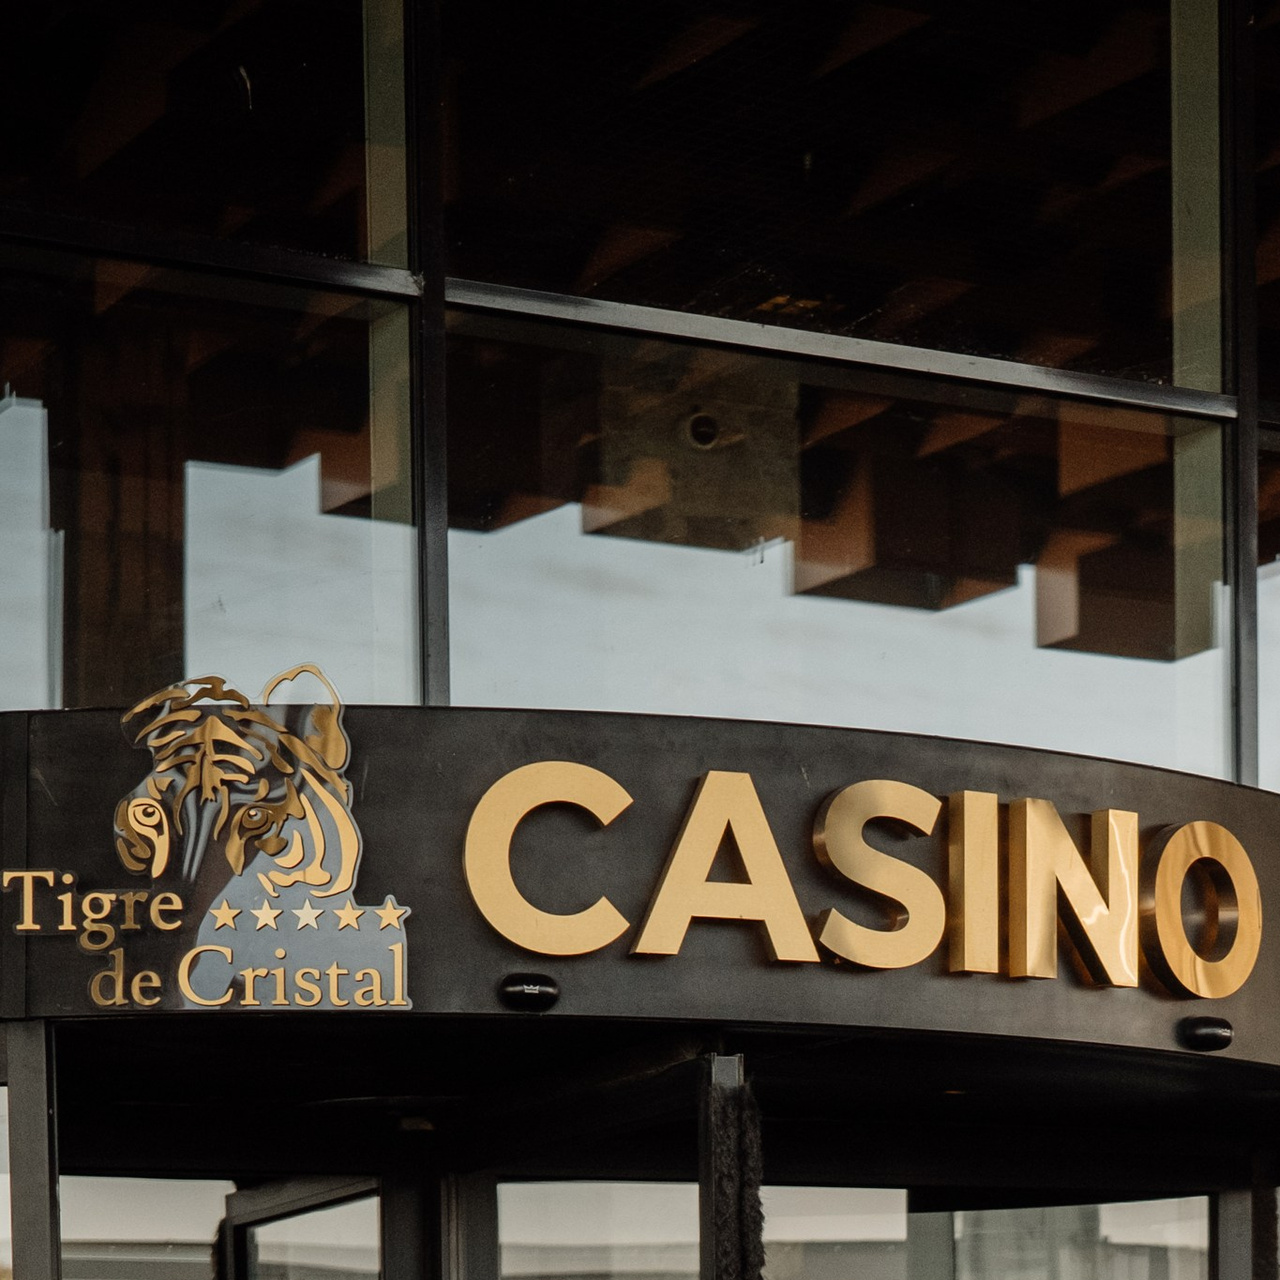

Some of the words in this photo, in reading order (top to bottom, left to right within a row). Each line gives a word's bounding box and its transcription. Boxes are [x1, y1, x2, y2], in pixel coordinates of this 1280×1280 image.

[2, 869, 183, 951] Tigre
[462, 760, 1263, 999] CASINO
[90, 947, 162, 1007] de
[177, 942, 410, 1008] Cristal
